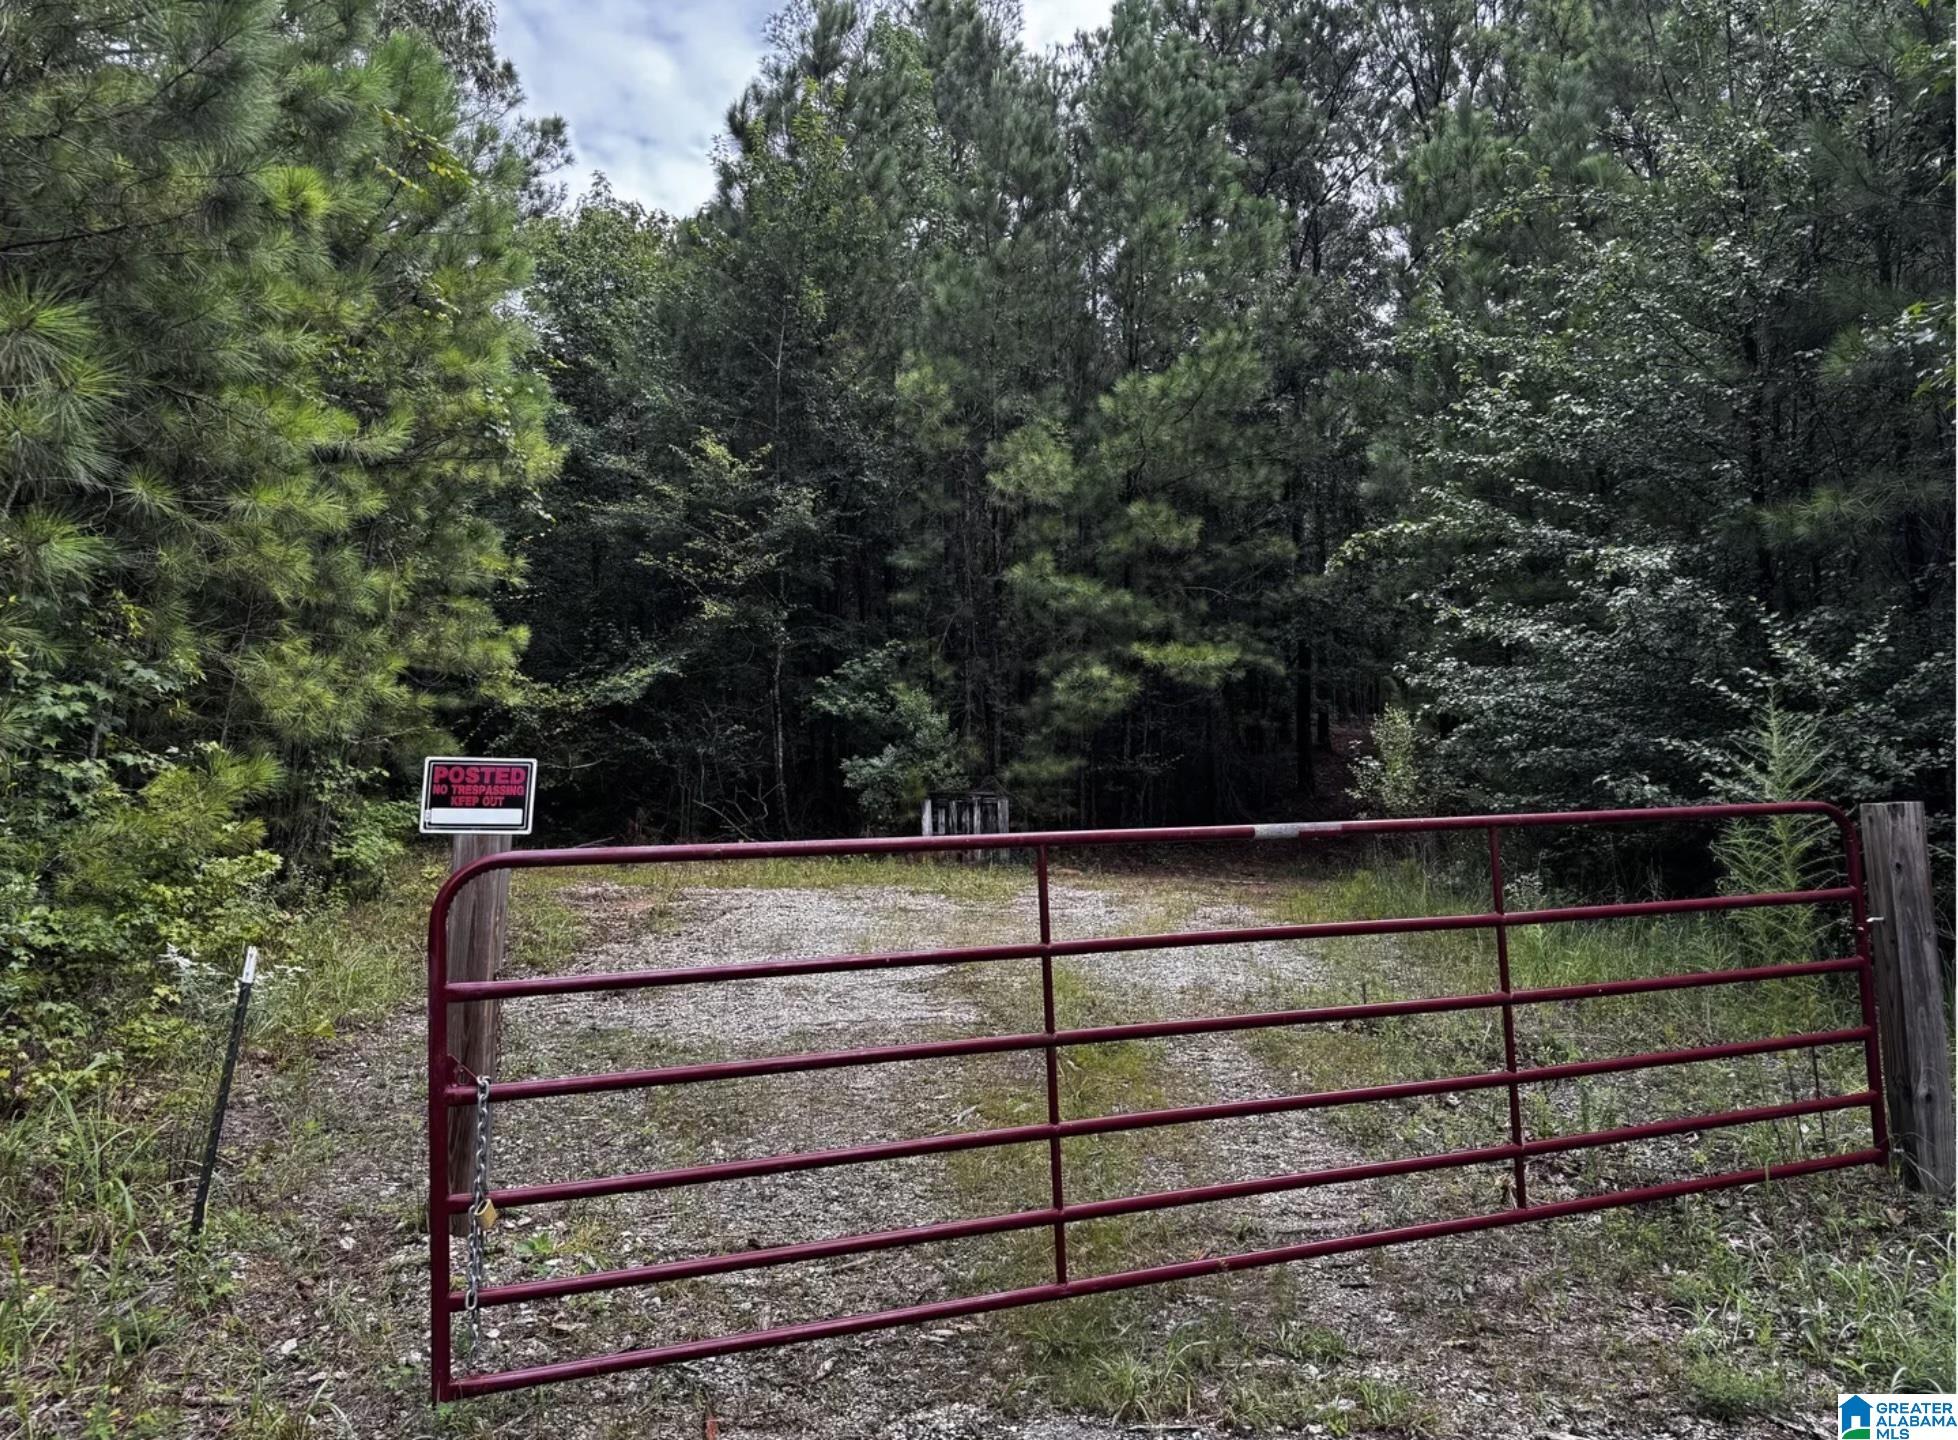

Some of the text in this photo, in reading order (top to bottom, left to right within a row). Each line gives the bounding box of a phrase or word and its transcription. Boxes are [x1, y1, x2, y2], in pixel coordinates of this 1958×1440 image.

[433, 766, 526, 785] POSTED
[432, 784, 525, 796] NO TRESPASSING
[450, 796, 505, 807] KEEP OUT
